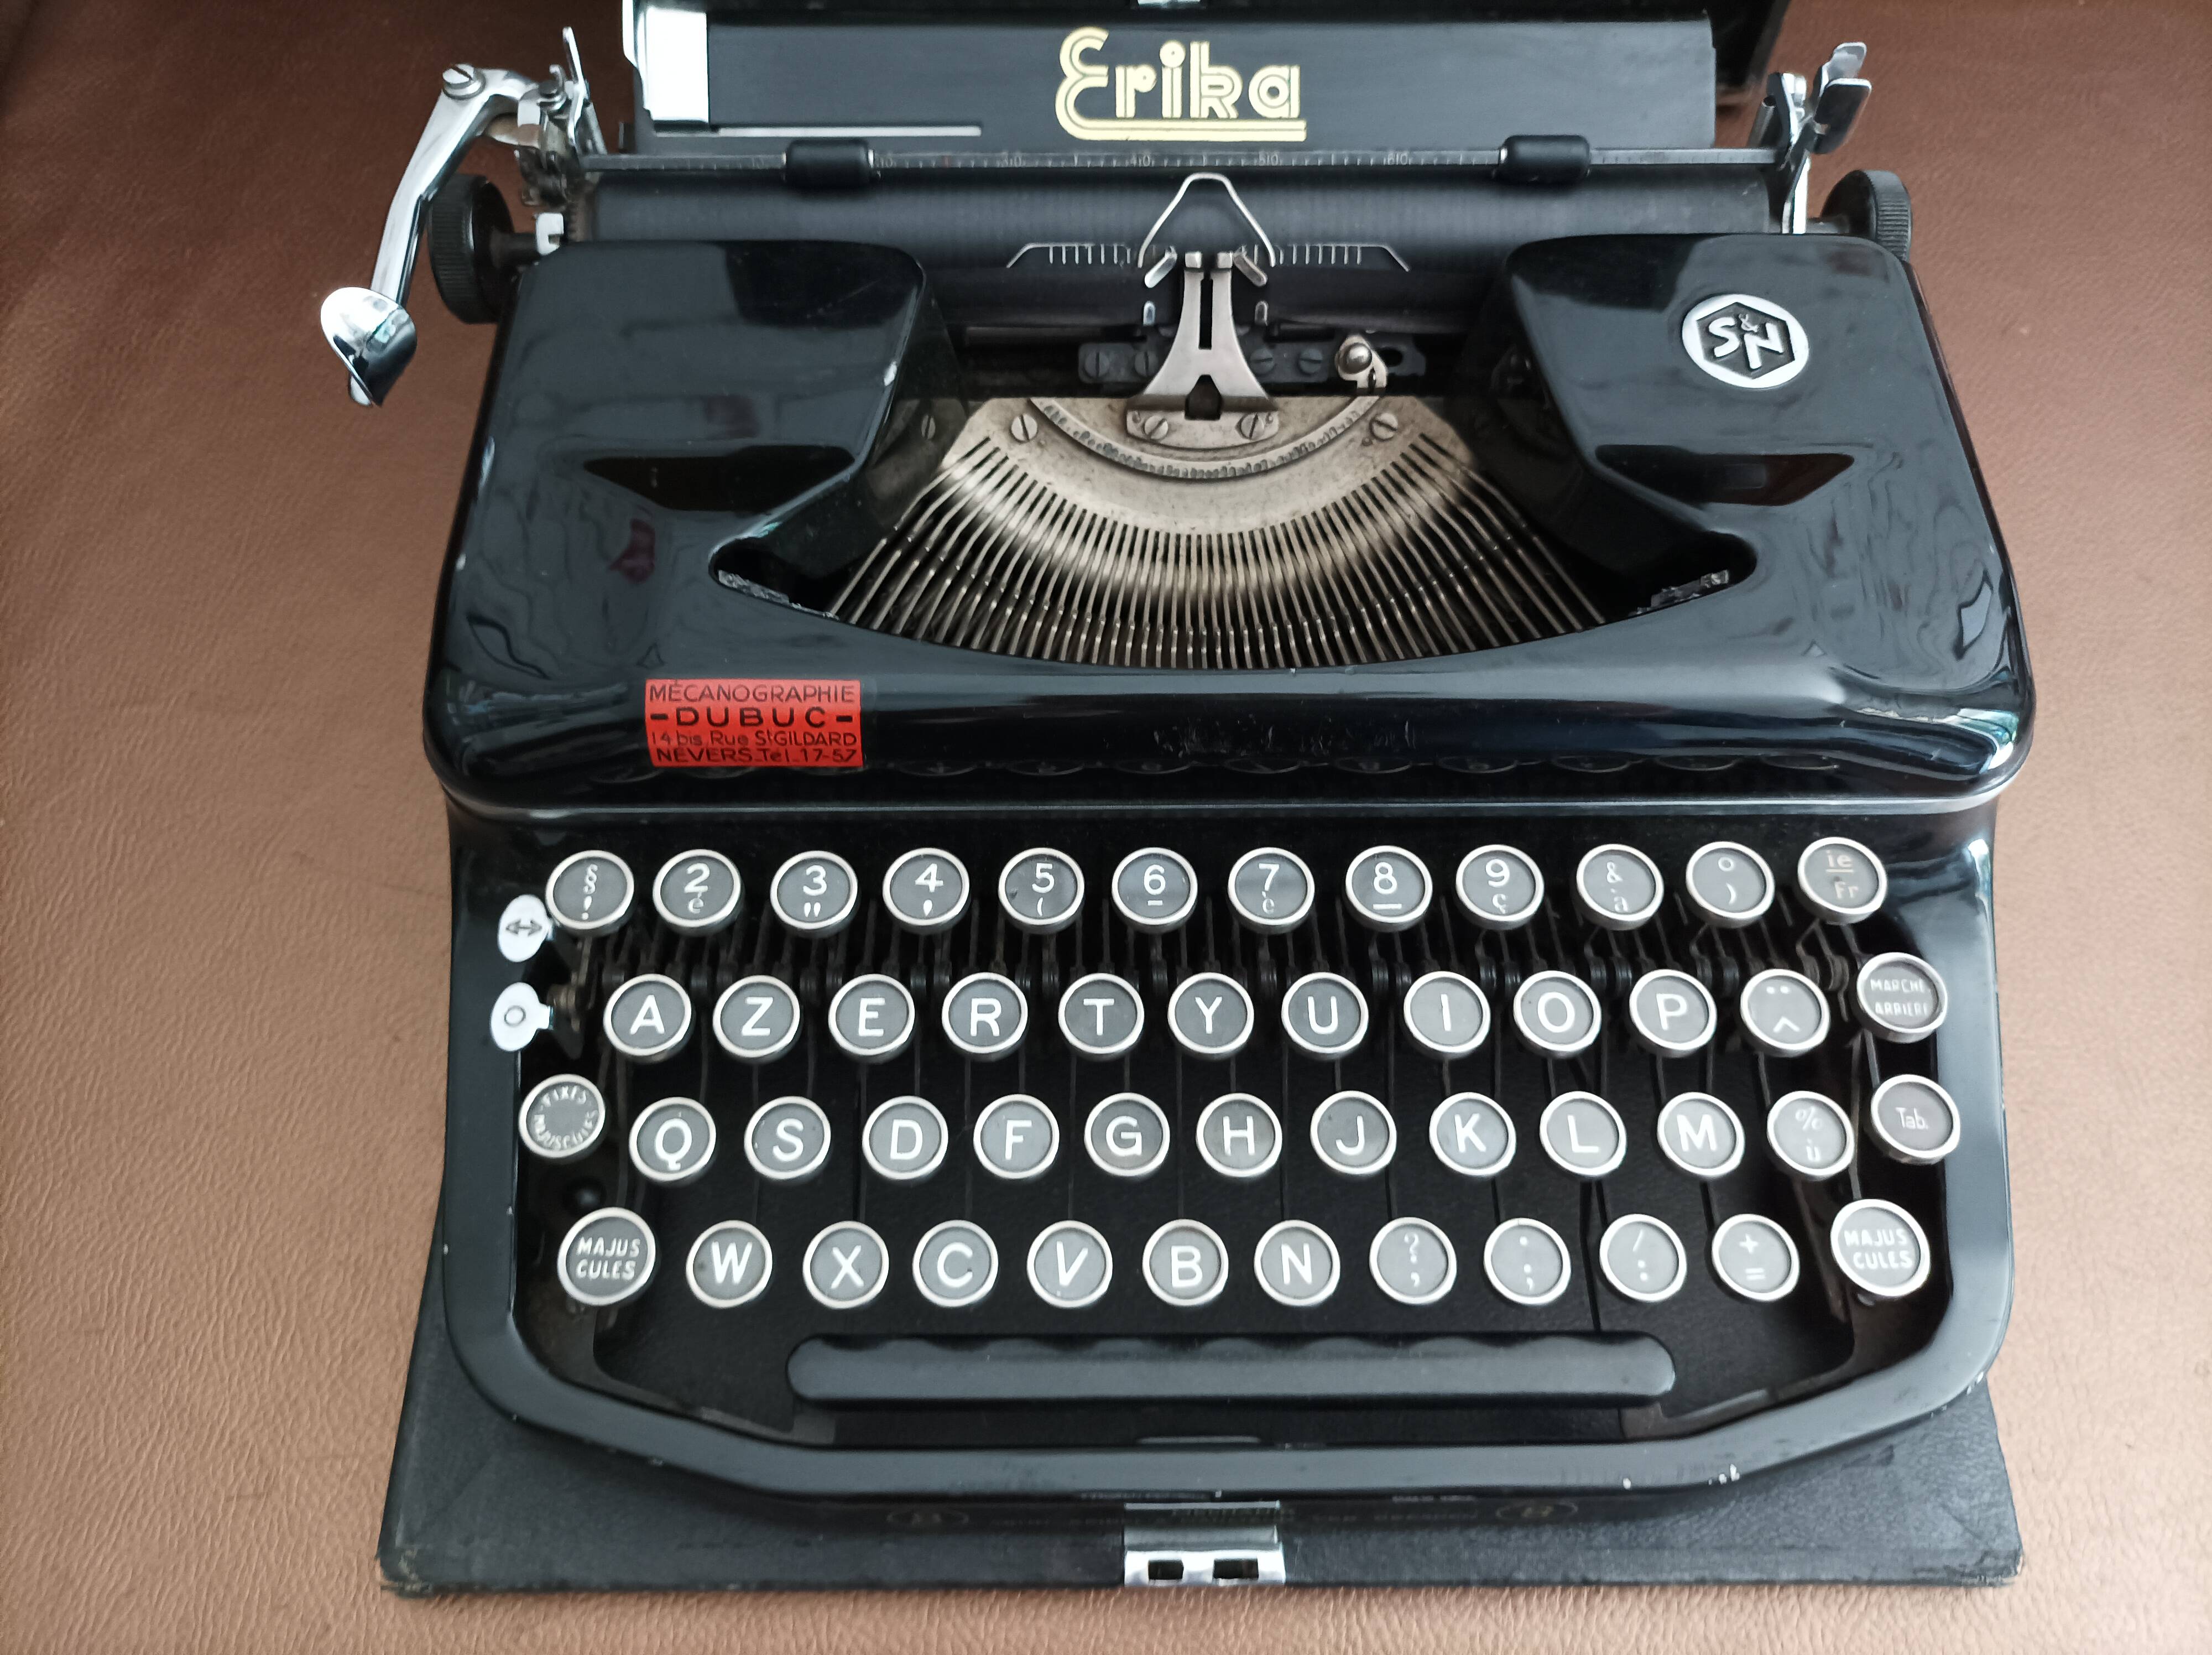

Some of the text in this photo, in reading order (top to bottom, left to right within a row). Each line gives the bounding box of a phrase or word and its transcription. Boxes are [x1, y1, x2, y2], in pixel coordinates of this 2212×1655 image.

[1055, 26, 1307, 142] Erika
[650, 680, 855, 703] MÉCANOGRAPHIE
[710, 730, 749, 746] Rue
[684, 863, 710, 894] 2
[802, 865, 827, 896] 3
[915, 863, 943, 893] 4
[1031, 862, 1055, 893] 5
[1144, 864, 1166, 895] 6
[1259, 863, 1280, 891] 7
[1373, 862, 1397, 895] 8
[1485, 858, 1510, 888] 9
[630, 995, 665, 1034] A
[741, 997, 773, 1037] Z
[858, 997, 885, 1037] E
[970, 998, 1001, 1037] R
[1083, 998, 1115, 1036] T
[1195, 997, 1222, 1034] Y
[1307, 996, 1338, 1034] U
[1441, 994, 1452, 1032] I
[1537, 992, 1575, 1033] O
[1656, 993, 1688, 1031] P
[654, 1117, 694, 1170] Q
[773, 1118, 804, 1162] S
[890, 1119, 923, 1160] D
[1005, 1120, 1032, 1160] F
[1105, 1116, 1142, 1157] G
[1223, 1116, 1256, 1157] H
[1335, 1116, 1365, 1157] J
[1454, 1113, 1486, 1153] K
[1567, 1115, 1600, 1154] L
[1676, 1114, 1718, 1152] M
[576, 1237, 640, 1258] MAJUS
[1739, 1234, 1759, 1254] +
[1844, 1228, 1908, 1247] MAJUS
[576, 1258, 637, 1281] CULES
[711, 1242, 753, 1284] W
[831, 1245, 864, 1289] X
[937, 1242, 973, 1288] C
[1056, 1241, 1088, 1287] V
[1171, 1246, 1203, 1288] B
[1281, 1243, 1312, 1285] N
[1853, 1251, 1913, 1271] CULES
